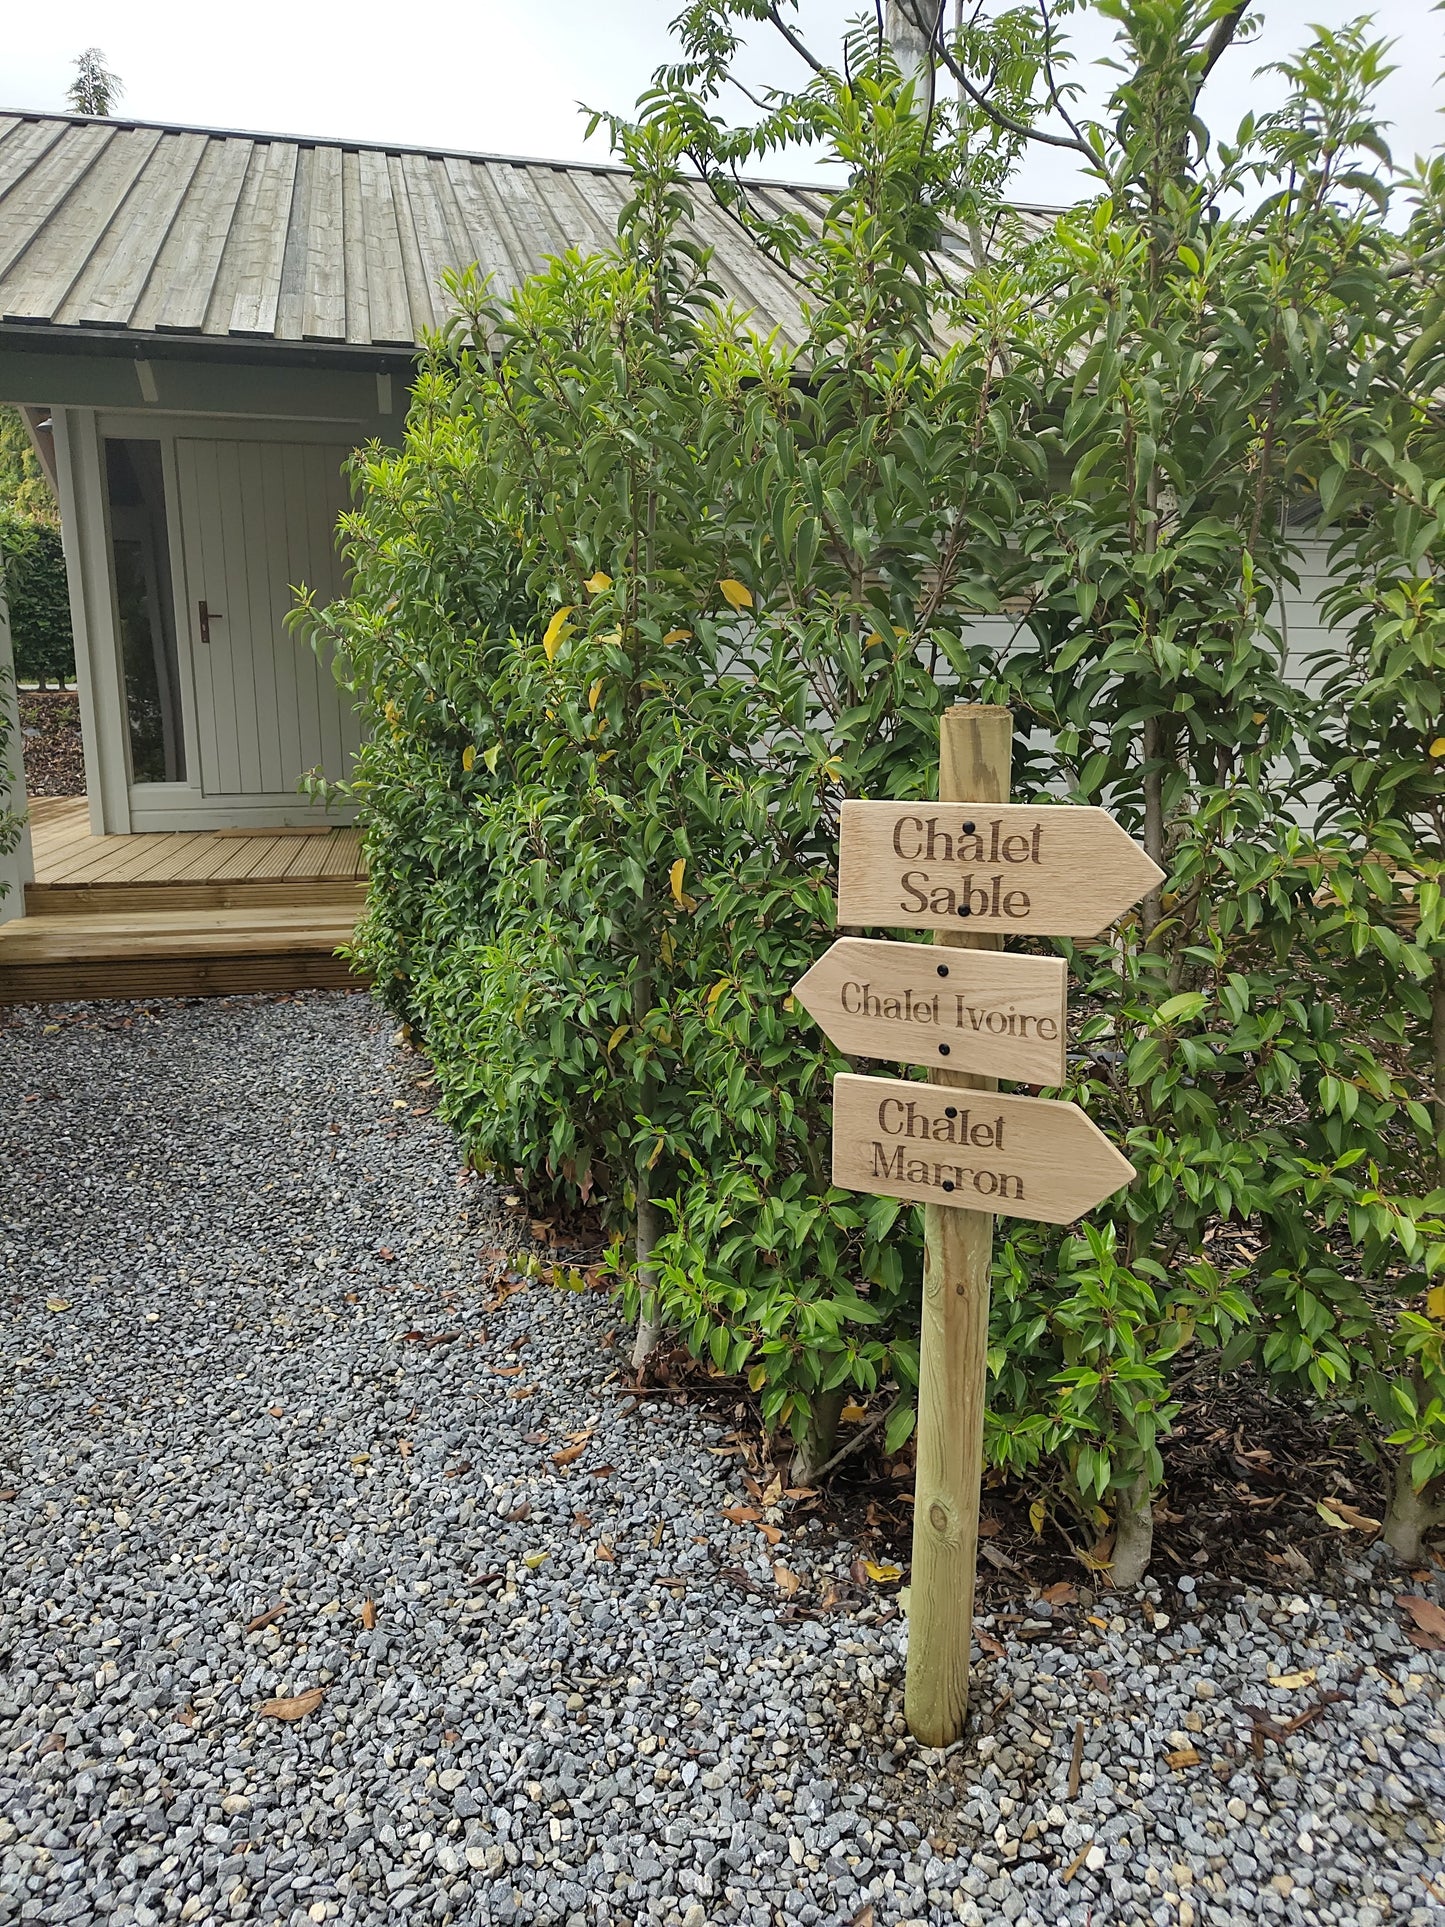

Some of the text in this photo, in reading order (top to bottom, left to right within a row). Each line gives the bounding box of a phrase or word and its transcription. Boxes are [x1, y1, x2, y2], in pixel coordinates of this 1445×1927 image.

[893, 816, 1044, 865] Chalet
[900, 871, 1031, 918] Sable
[841, 981, 1058, 1040] Chalet Ivoire
[878, 1098, 1006, 1150] Chalet
[871, 1141, 1025, 1200] Marron
